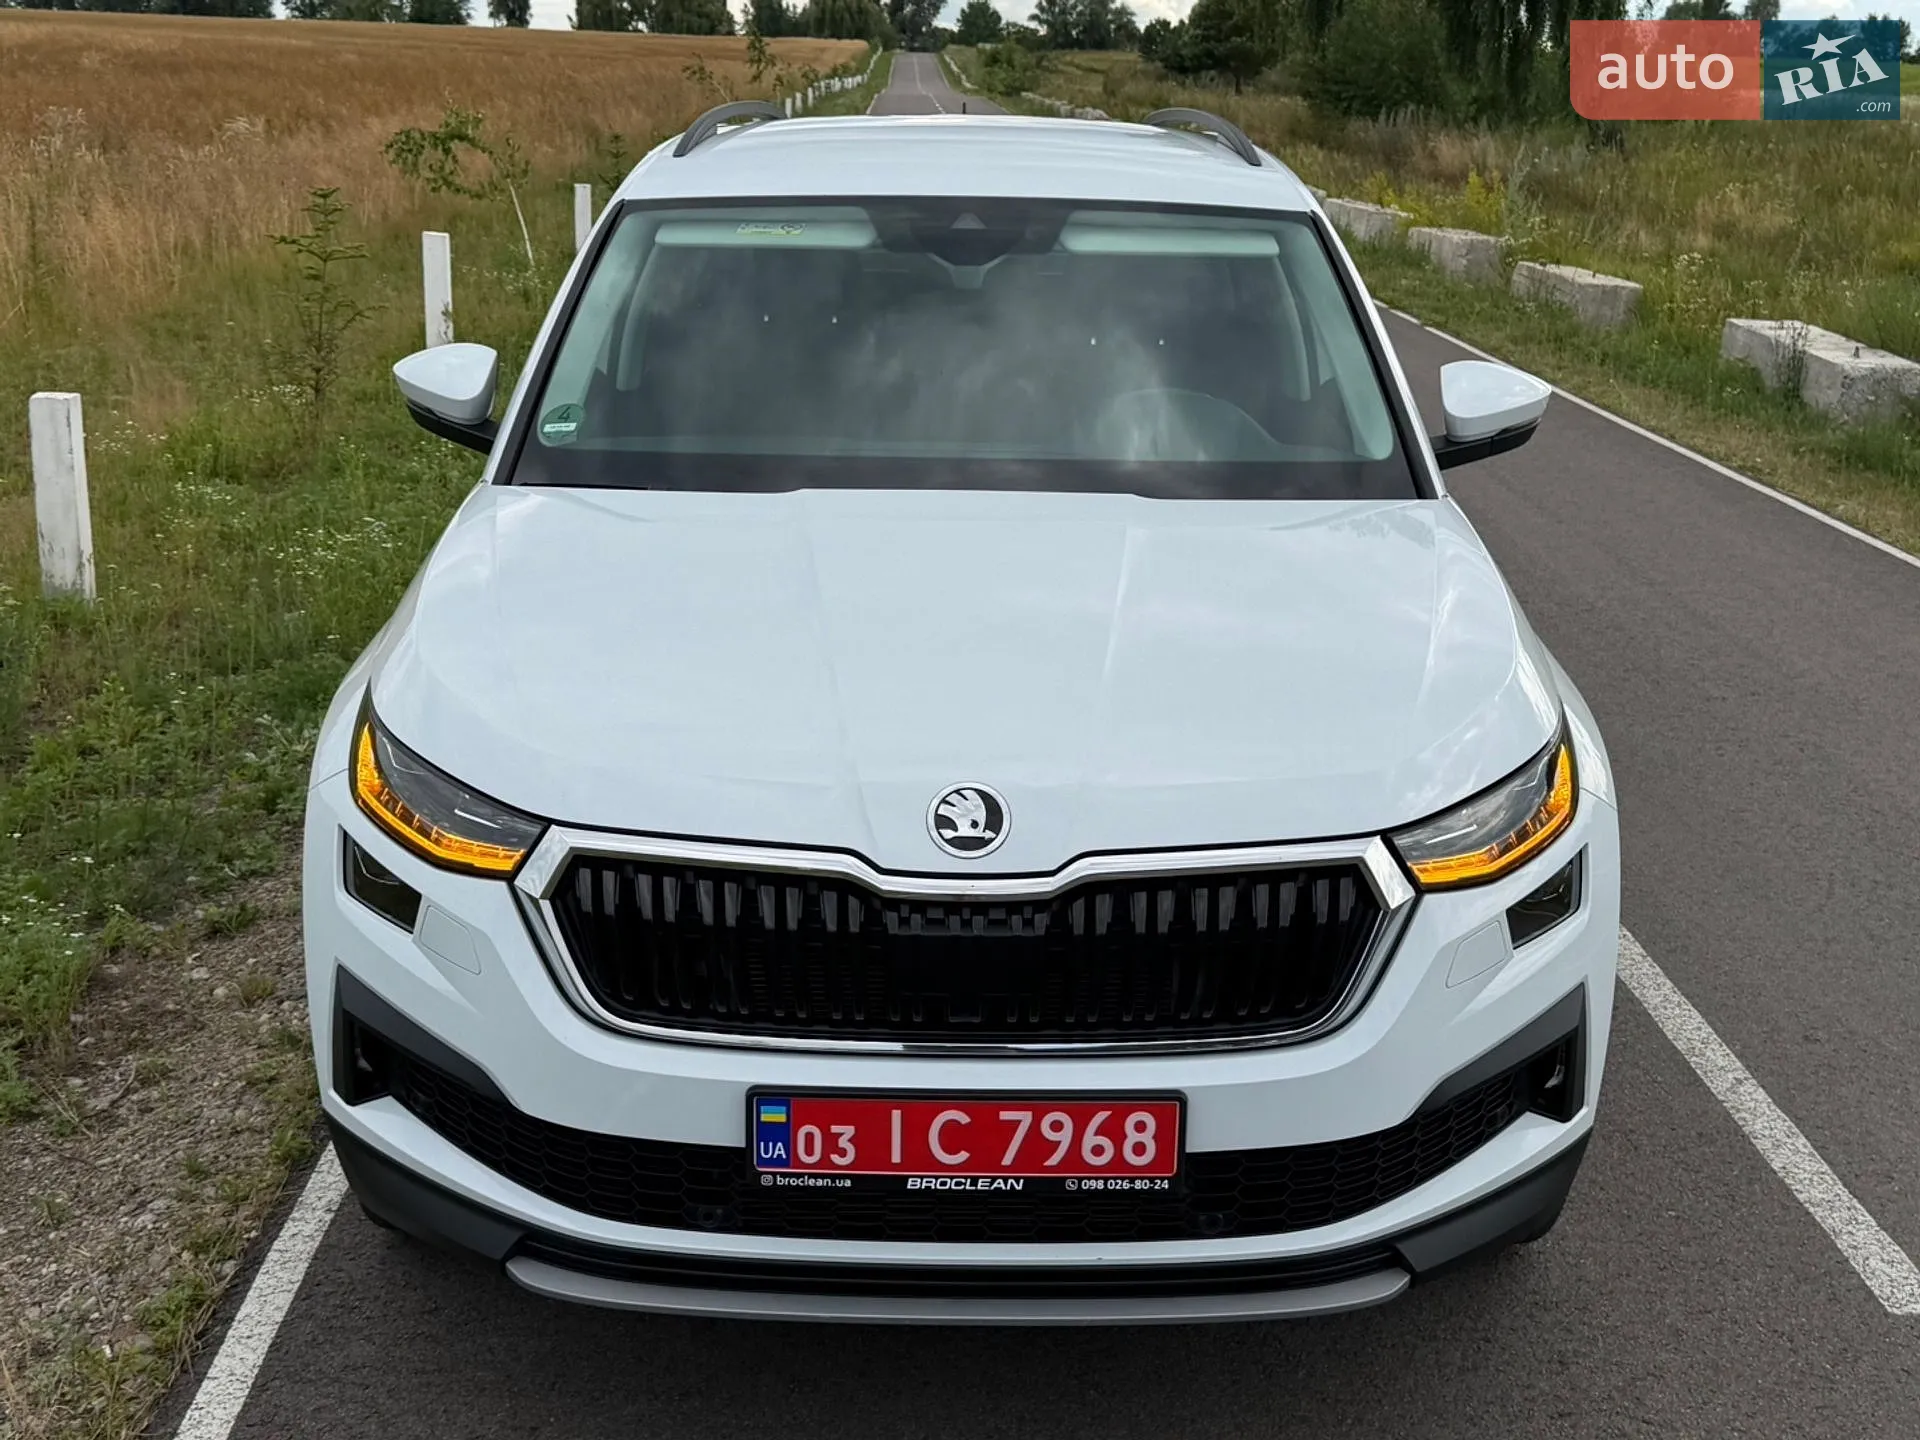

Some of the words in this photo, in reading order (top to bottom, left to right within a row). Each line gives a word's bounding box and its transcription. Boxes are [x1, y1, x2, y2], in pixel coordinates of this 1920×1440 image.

[557, 406, 571, 423] 4
[797, 1124, 857, 1166] 03
[998, 1109, 1157, 1167] 7968
[760, 1142, 787, 1159] UA
[776, 1175, 852, 1187] broclean.ua
[906, 1177, 1024, 1190] BROCLEAN
[1081, 1178, 1105, 1190] 098
[1107, 1178, 1169, 1190] 026-80-24
